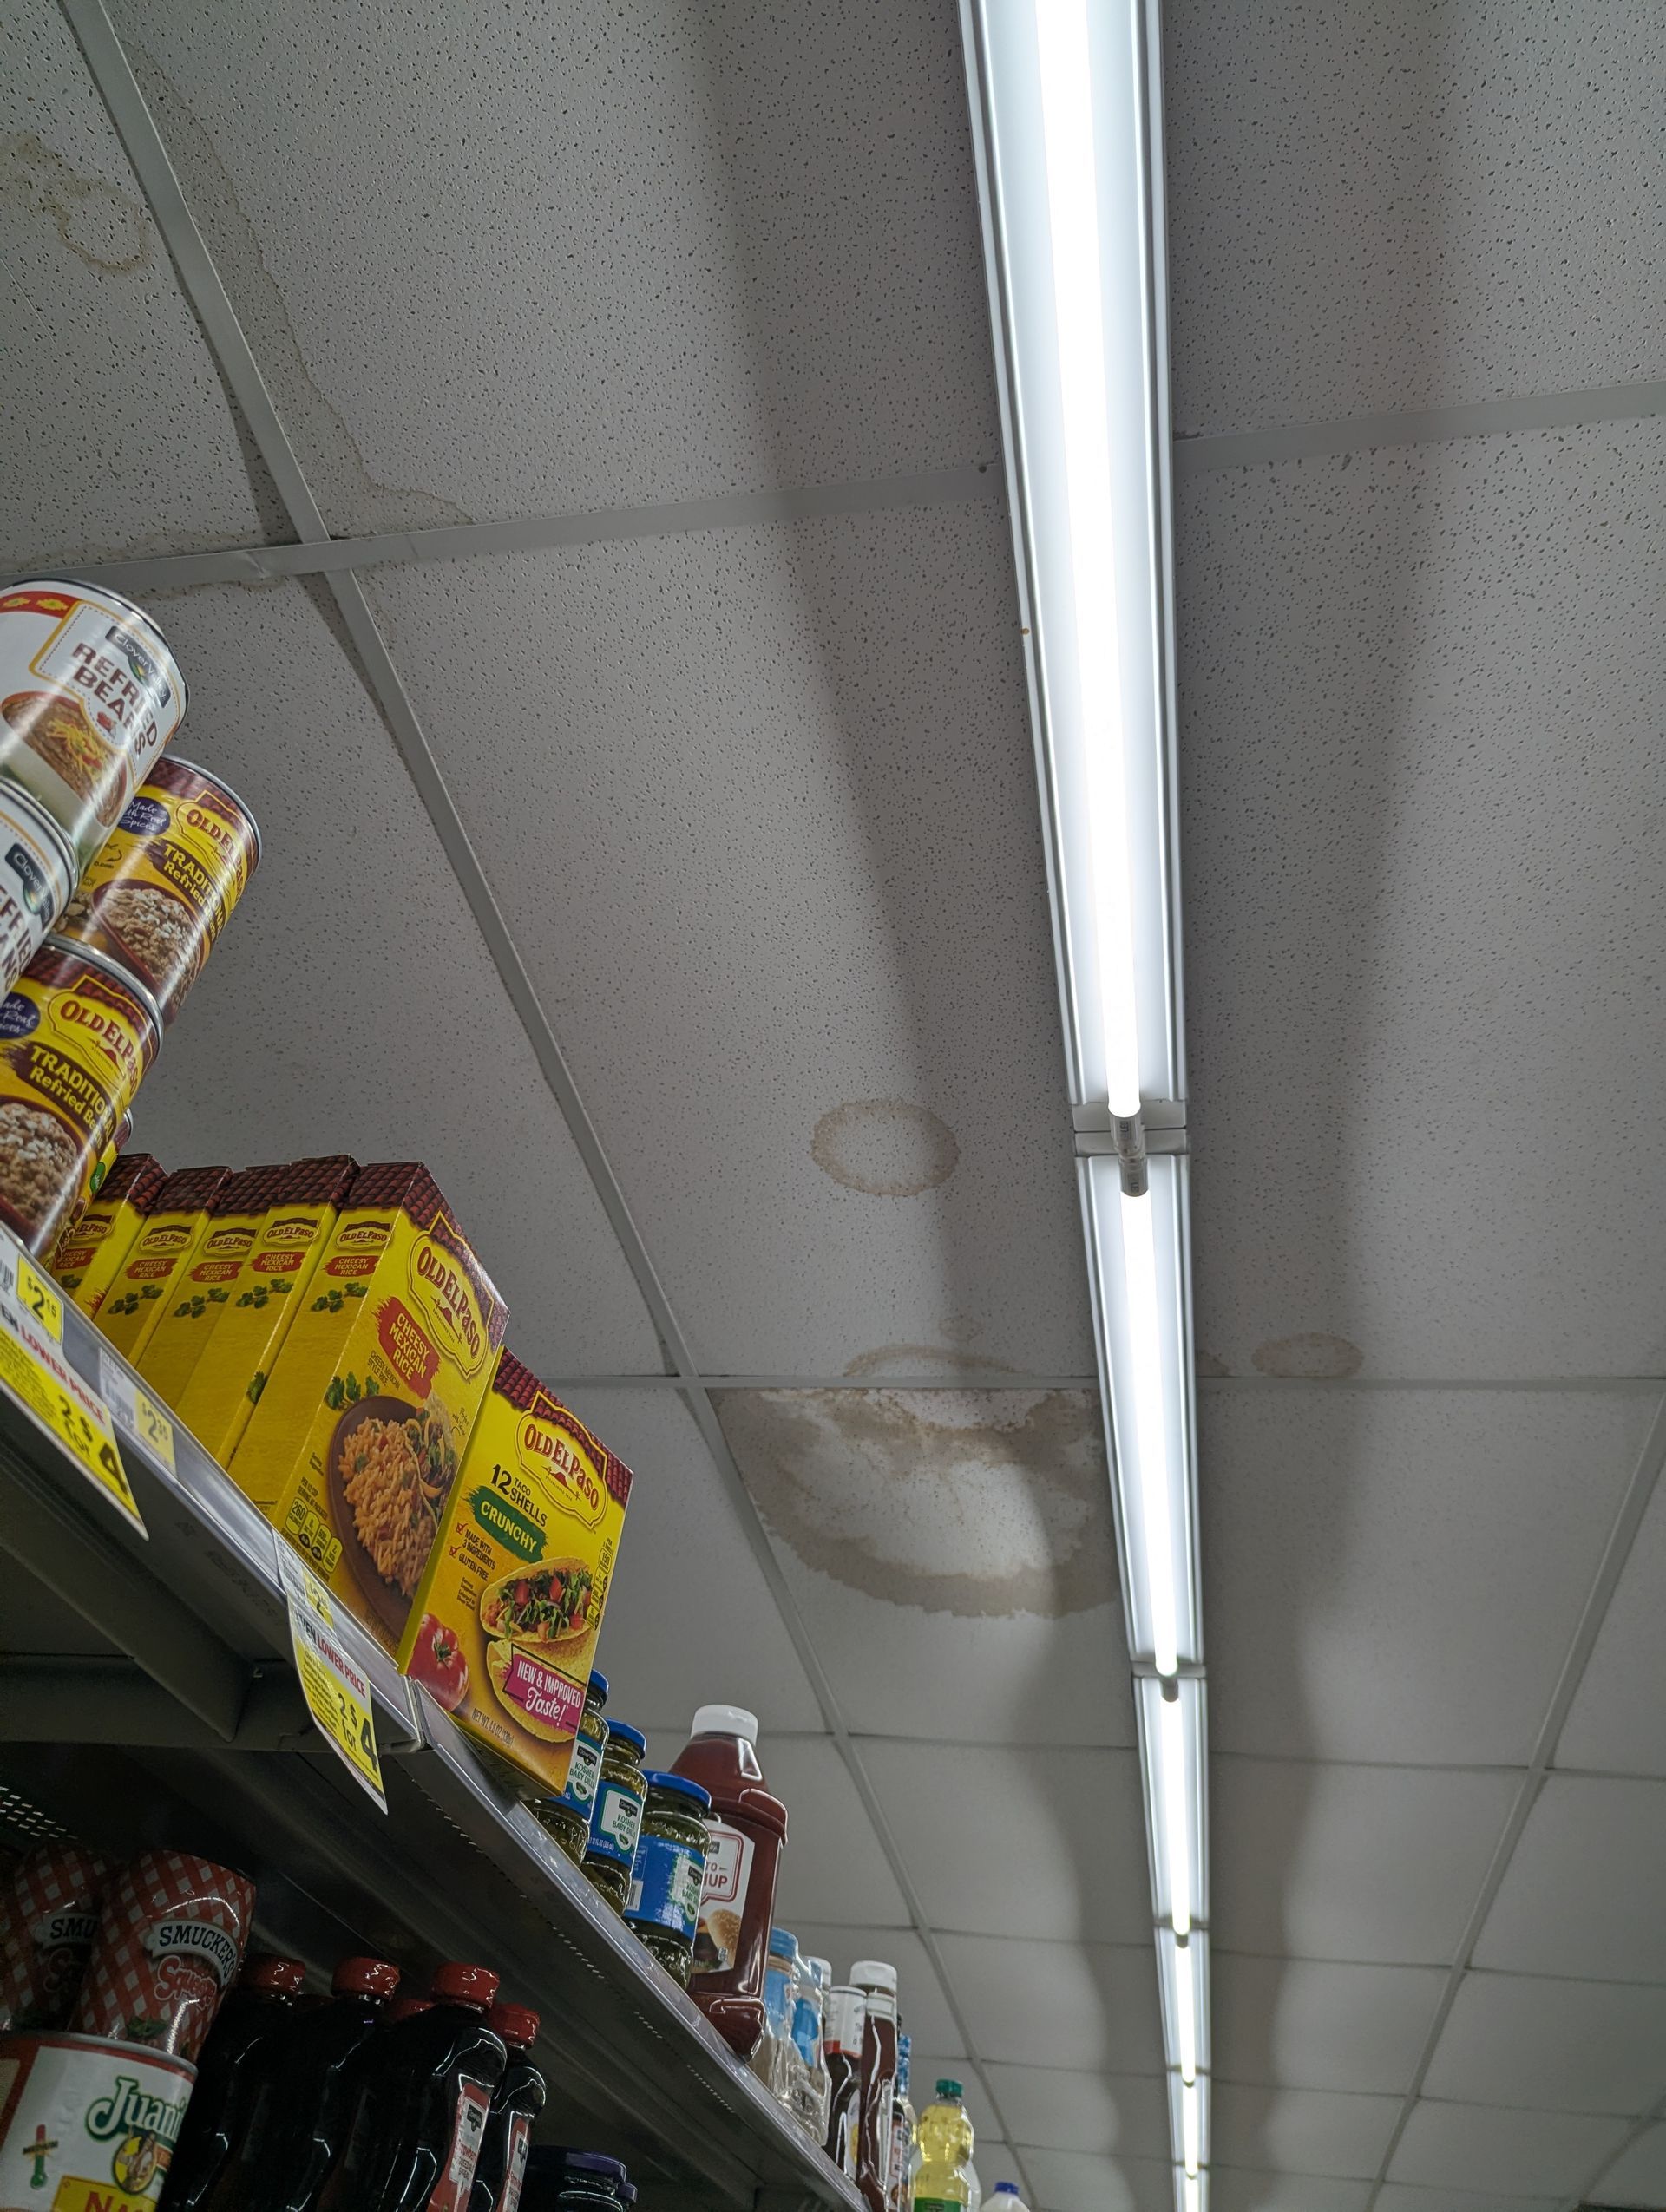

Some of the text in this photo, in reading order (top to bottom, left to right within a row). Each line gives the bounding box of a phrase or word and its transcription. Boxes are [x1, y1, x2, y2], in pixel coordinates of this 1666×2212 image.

[186, 808, 223, 839] OLD
[163, 860, 206, 907] Refried
[3, 999, 25, 1011] ade
[60, 999, 106, 1033] OLD
[102, 1018, 127, 1052] EL
[30, 1066, 87, 1115] Refried
[142, 1236, 161, 1246] OLD
[207, 1239, 226, 1249] OLD
[267, 1228, 285, 1239] OLD
[339, 1232, 358, 1242] OLD
[138, 1260, 167, 1268] CHEESY
[334, 1262, 369, 1271] MEXICAN
[416, 1245, 448, 1291] OLD
[441, 1268, 462, 1311] EL
[389, 1321, 428, 1379] MEXICAN
[396, 1312, 431, 1360] CHEESY
[19, 1325, 68, 1383] LOWER
[67, 1377, 106, 1425] PRICE
[366, 1359, 390, 1387] STYLE RICE
[370, 1350, 402, 1391] CHEESY MEXICAN
[391, 1349, 414, 1381] RICE
[523, 1423, 551, 1458] OLD
[551, 1438, 570, 1471] EL
[489, 1463, 532, 1497] 12 TACO
[291, 1500, 306, 1521] 260
[509, 1488, 548, 1528] SHELLS
[464, 1528, 493, 1554] MADE WITH
[480, 1500, 538, 1554] CRUNCHY
[458, 1552, 490, 1583] GLUTEN FREE
[466, 1541, 497, 1571] INGREDIENTS
[318, 1633, 344, 1676] LOWER
[344, 1665, 366, 1698] PRICE
[517, 1659, 581, 1709] NEW & IMPROVED
[471, 1706, 482, 1721] NET
[525, 1685, 567, 1728] Taste!
[360, 1717, 378, 1776] 4
[569, 1768, 585, 1782] BABY
[575, 1761, 595, 1778] KOSHER
[612, 1820, 626, 1833] BABY
[617, 1814, 636, 1830] KOSHER
[159, 1924, 236, 1979] SMUCKER'S
[85, 2074, 186, 2142] Juani
